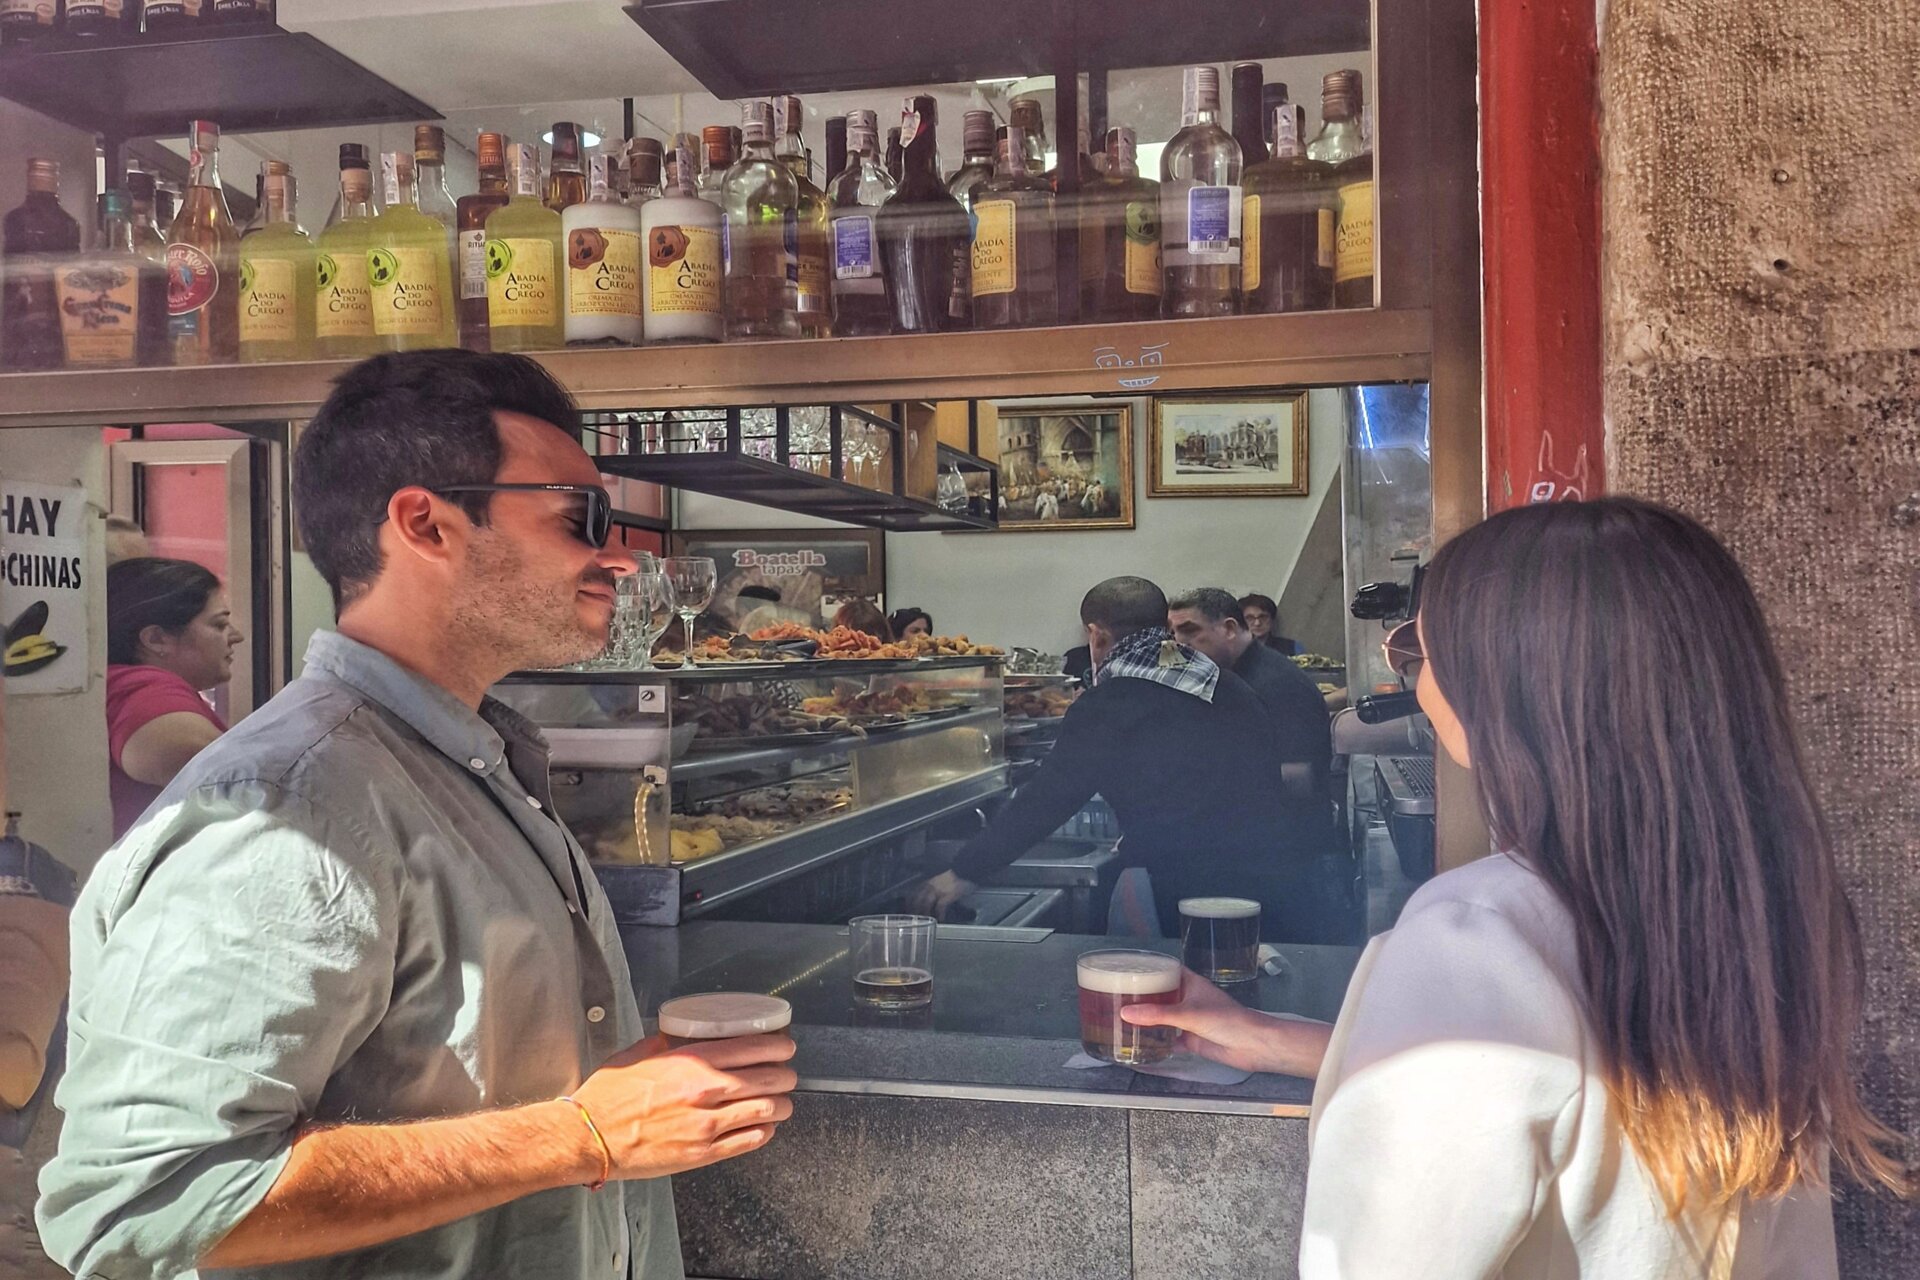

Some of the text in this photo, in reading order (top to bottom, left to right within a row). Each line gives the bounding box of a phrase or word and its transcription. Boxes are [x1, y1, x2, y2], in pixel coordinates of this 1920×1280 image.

[597, 261, 636, 275] ABADÍA
[972, 256, 1003, 270] CREGO
[506, 272, 546, 285] ABADÍA
[595, 276, 635, 290] CREGO
[677, 275, 715, 289] CREGO
[394, 281, 433, 294] ABADÍA
[505, 287, 545, 301] CREGO
[329, 300, 367, 312] CREGO
[393, 296, 433, 310] CREGO
[247, 304, 284, 317] CREGO
[1, 494, 61, 537] HAY
[733, 549, 826, 566] Boatella
[761, 564, 803, 576] tapas
